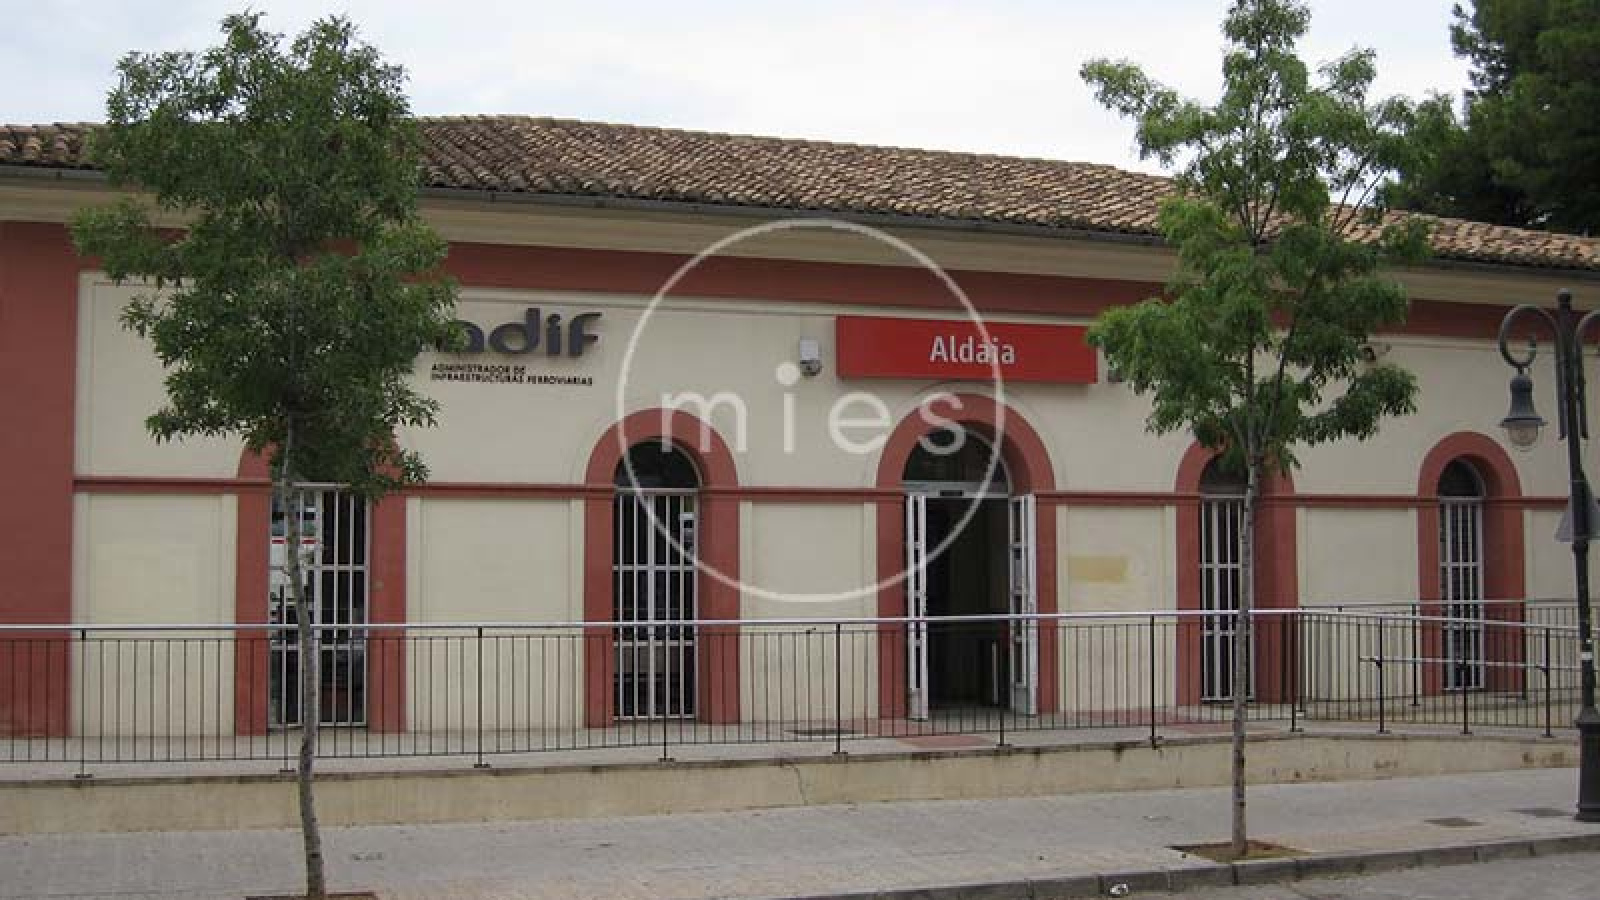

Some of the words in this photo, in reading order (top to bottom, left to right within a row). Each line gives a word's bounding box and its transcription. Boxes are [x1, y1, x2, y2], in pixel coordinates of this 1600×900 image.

[431, 364, 510, 373] ADMINISTRADOR
[513, 365, 526, 374] DE
[431, 373, 524, 383] INFRAESTRUCTURAS
[527, 375, 593, 386] FERROVIARIAS
